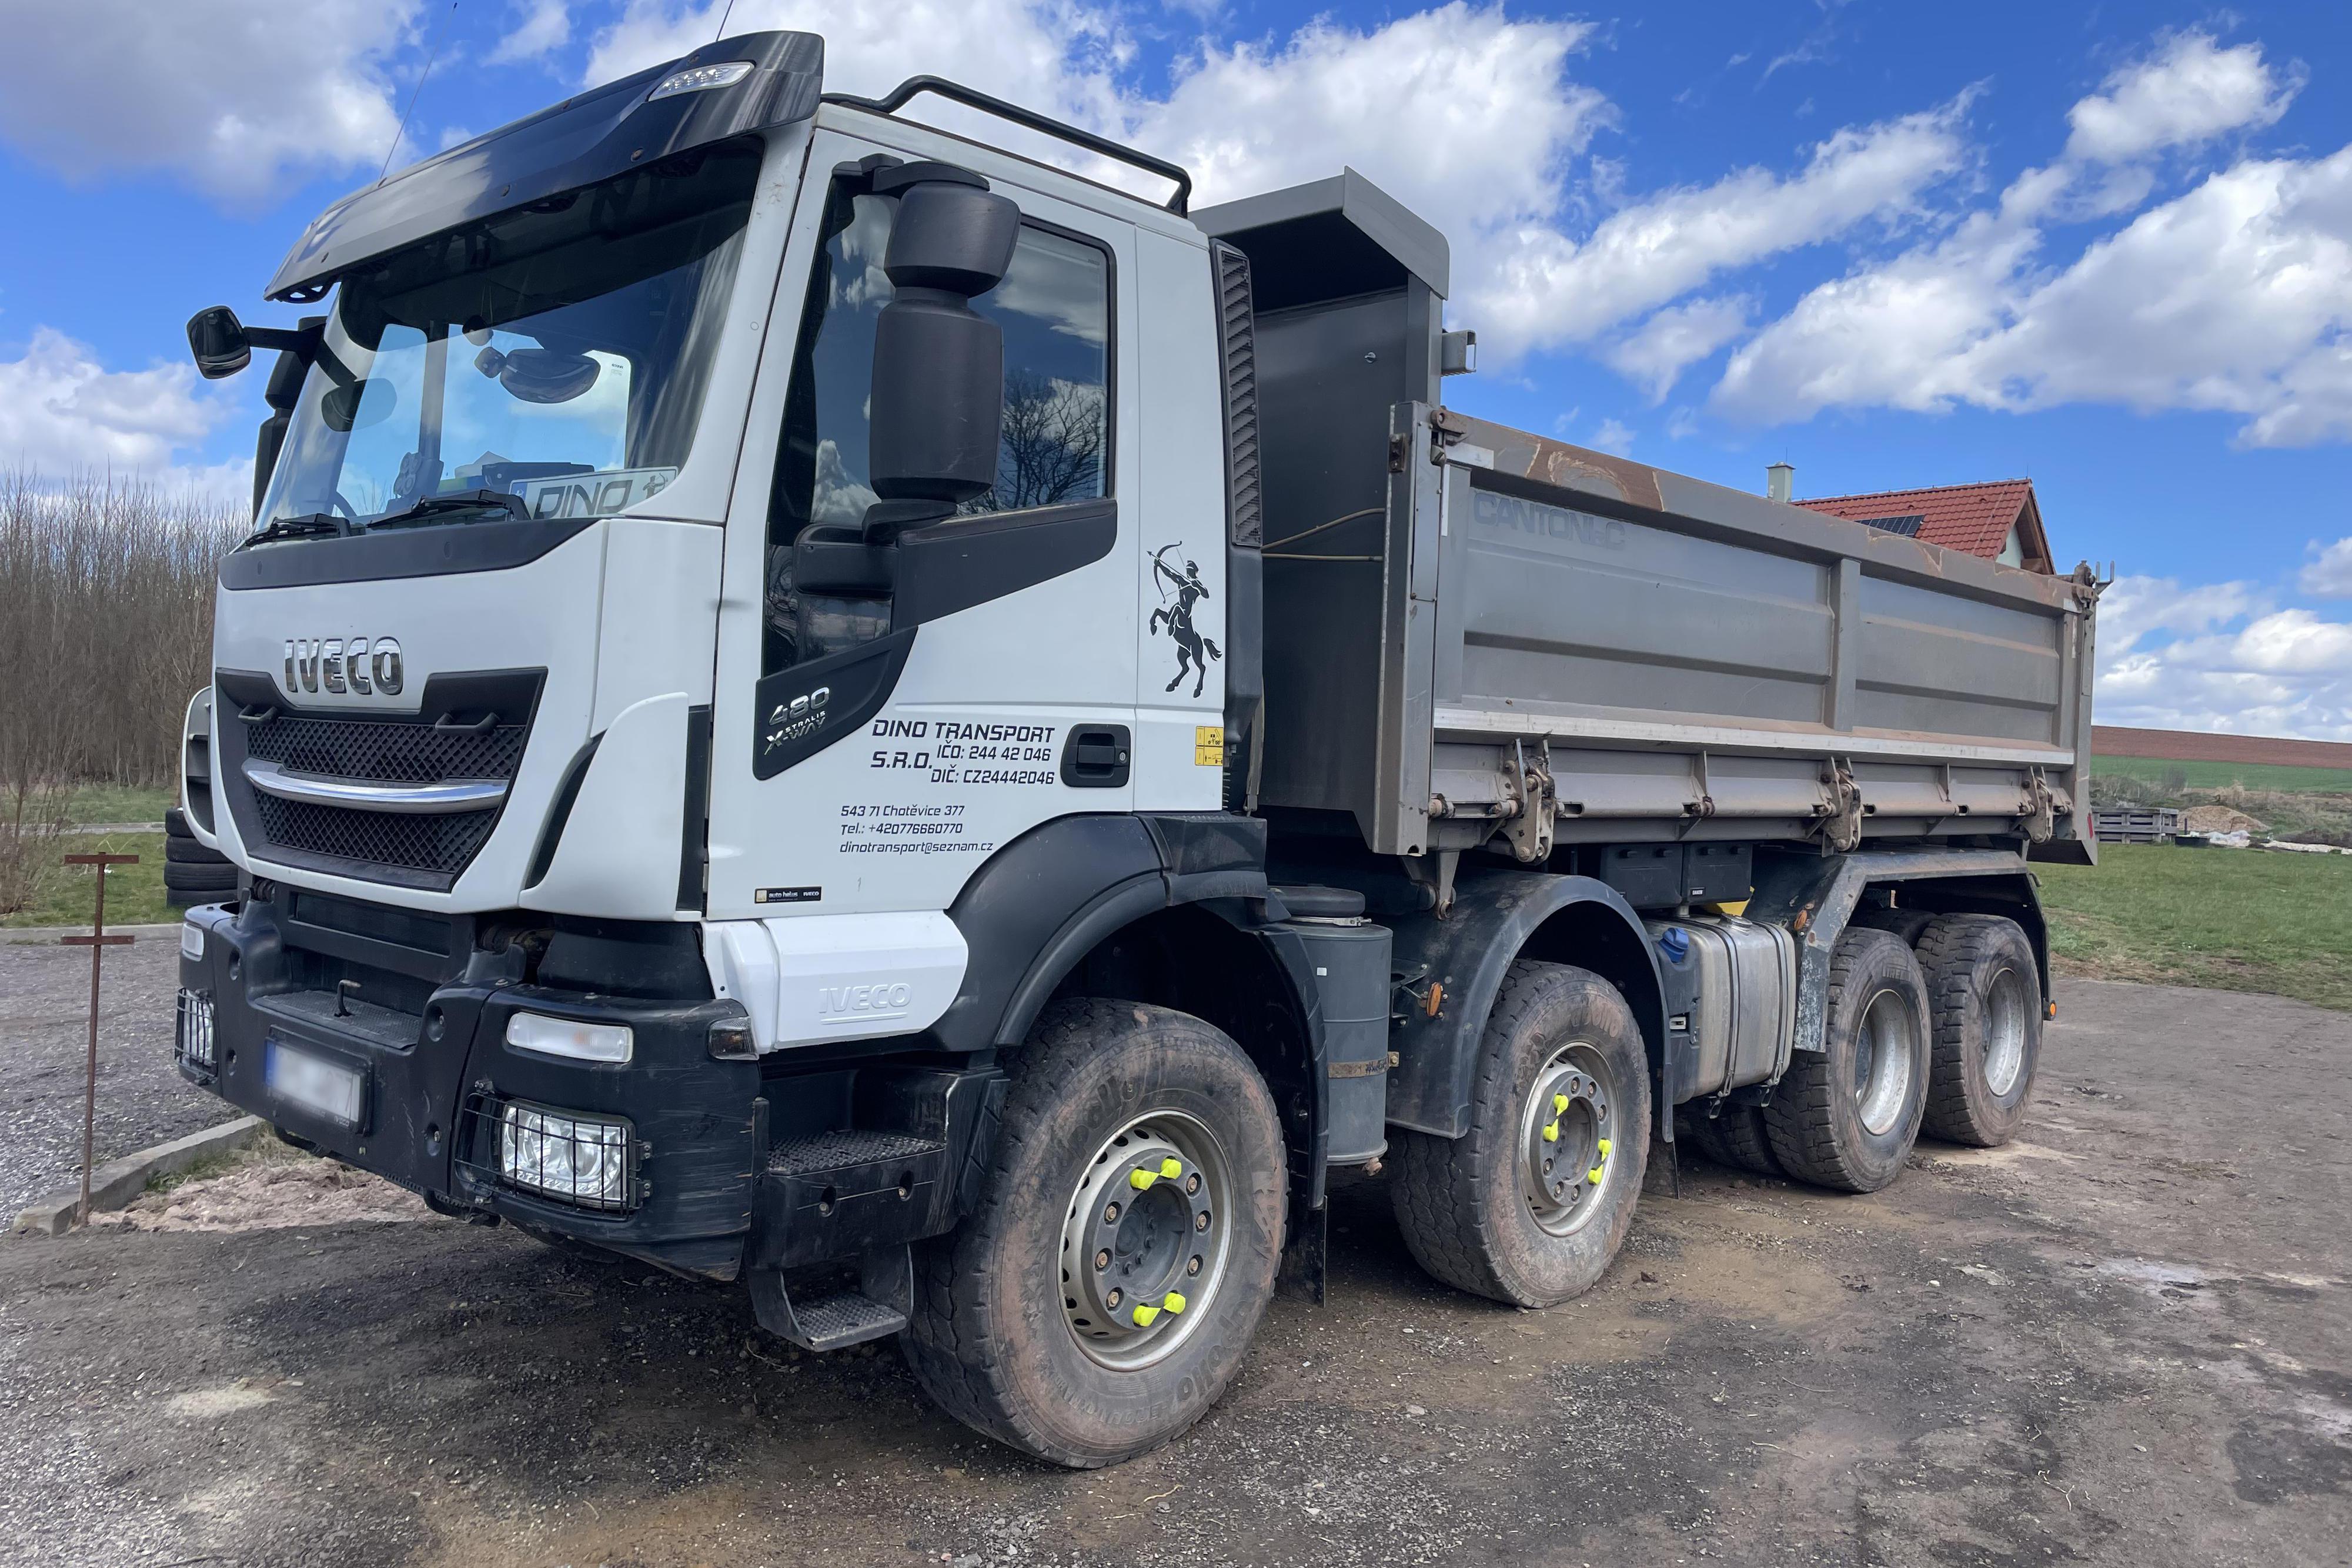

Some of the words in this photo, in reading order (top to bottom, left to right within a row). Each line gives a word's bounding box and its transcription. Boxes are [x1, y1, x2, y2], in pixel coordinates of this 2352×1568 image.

[532, 479, 633, 520] DINO
[285, 636, 404, 696] IVECO
[769, 687, 830, 726] 480
[785, 710, 826, 733] STRALIS
[872, 719, 928, 738] DINO
[935, 721, 1055, 743] TRANSPORT
[764, 717, 826, 755] X-WAY
[870, 751, 933, 769] S.R.O.
[937, 740, 964, 759] IČO:
[968, 745, 997, 760] 244
[1001, 747, 1020, 761] 42
[1023, 747, 1051, 761] 046
[931, 764, 959, 783] DIČ:
[963, 770, 1055, 784] CZ24442046
[841, 805, 866, 817] 543
[869, 805, 880, 817] 71
[883, 804, 941, 817] Chotěvice
[944, 805, 965, 816] 377
[841, 822, 865, 835] Tel.:
[868, 823, 963, 834] +420776660770
[840, 841, 994, 855] dinotransport@seznam.cz
[818, 982, 912, 1014] IVECO
